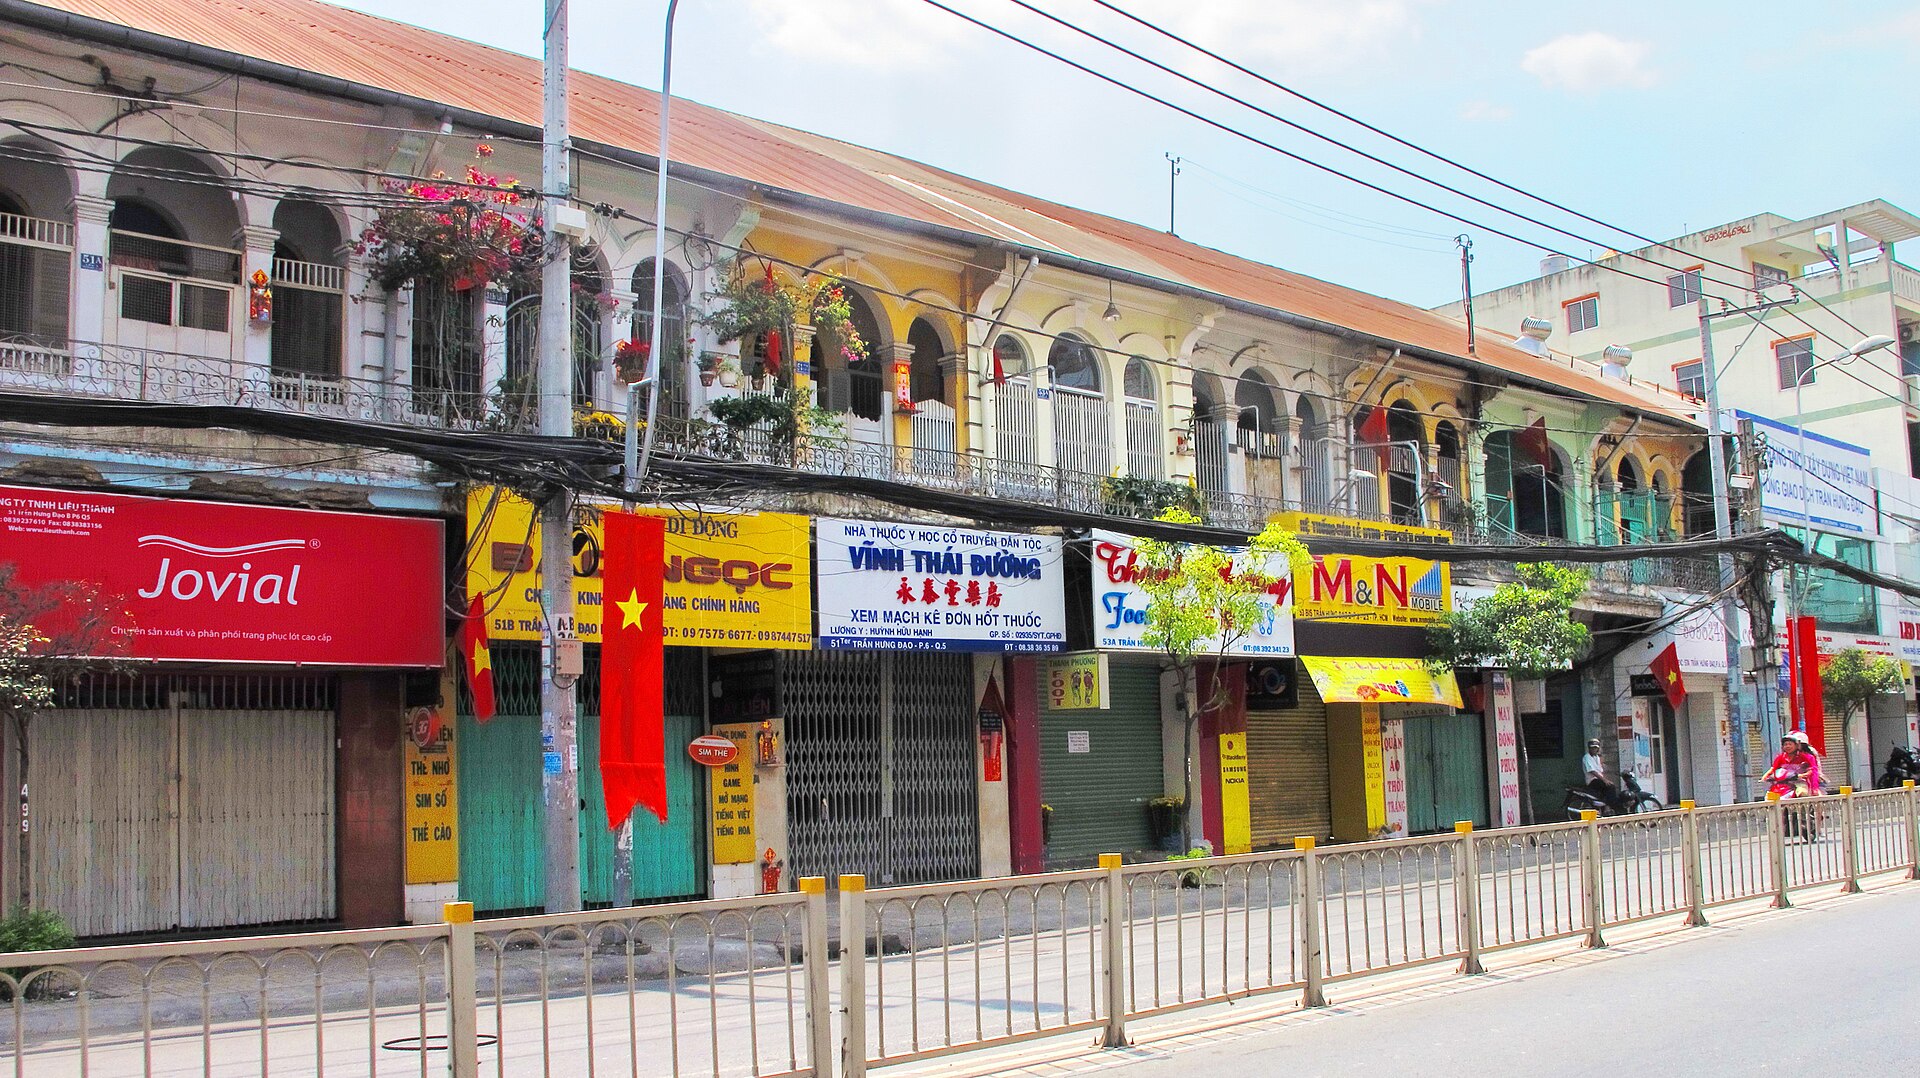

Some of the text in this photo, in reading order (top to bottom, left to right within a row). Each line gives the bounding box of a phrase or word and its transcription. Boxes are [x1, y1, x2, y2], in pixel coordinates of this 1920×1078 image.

[82, 254, 102, 264] 51A
[14, 499, 26, 508] TY
[28, 500, 56, 510] TNHH
[34, 510, 50, 518] Hưng
[26, 526, 90, 536] www.lieuthanh.com
[668, 516, 738, 540] DI ĐỘNG
[844, 524, 866, 537] NHÀ
[870, 525, 906, 540] THUỐC
[909, 530, 916, 540] Y
[918, 532, 940, 545] HỌC
[943, 528, 958, 544] CỔ
[1001, 536, 1020, 548] DÂN
[1023, 537, 1042, 552] TỘC
[848, 540, 1042, 580] VĨNH THÁI ĐƯỜNG
[138, 558, 301, 606] Jovial
[664, 592, 686, 610] ÀNG
[692, 596, 726, 612] CHÍNH
[730, 597, 760, 614] HÃNG
[1411, 597, 1444, 612] MOBILE
[850, 608, 1042, 628] XEM MẠCH KÊ ĐƠN HỐT THUỐC
[494, 619, 514, 630] 51B
[578, 623, 598, 636] ĐẠO
[830, 626, 856, 635] LƯƠNG
[858, 627, 864, 635] Y
[914, 628, 932, 638] HẠNH
[186, 628, 196, 637] và
[198, 629, 220, 639] phân
[242, 632, 264, 642] trang
[288, 632, 300, 640] lót
[318, 633, 332, 643] cấp
[1102, 638, 1116, 646] 53A
[1118, 636, 1136, 647] TRẦN
[852, 638, 873, 648] TRẦN
[874, 640, 896, 649] HƯNG
[897, 641, 914, 650] ĐẠO
[1052, 670, 1064, 706] FOOT
[698, 746, 728, 758] SIM THẺ
[412, 756, 428, 776] THẺ
[723, 778, 740, 788] GAME
[416, 788, 447, 808] SIM SỐ
[716, 808, 750, 822] TIẾNG VIỆT
[412, 821, 452, 842] THẺ CÀO
[716, 824, 750, 836] TIẾNG HOA
